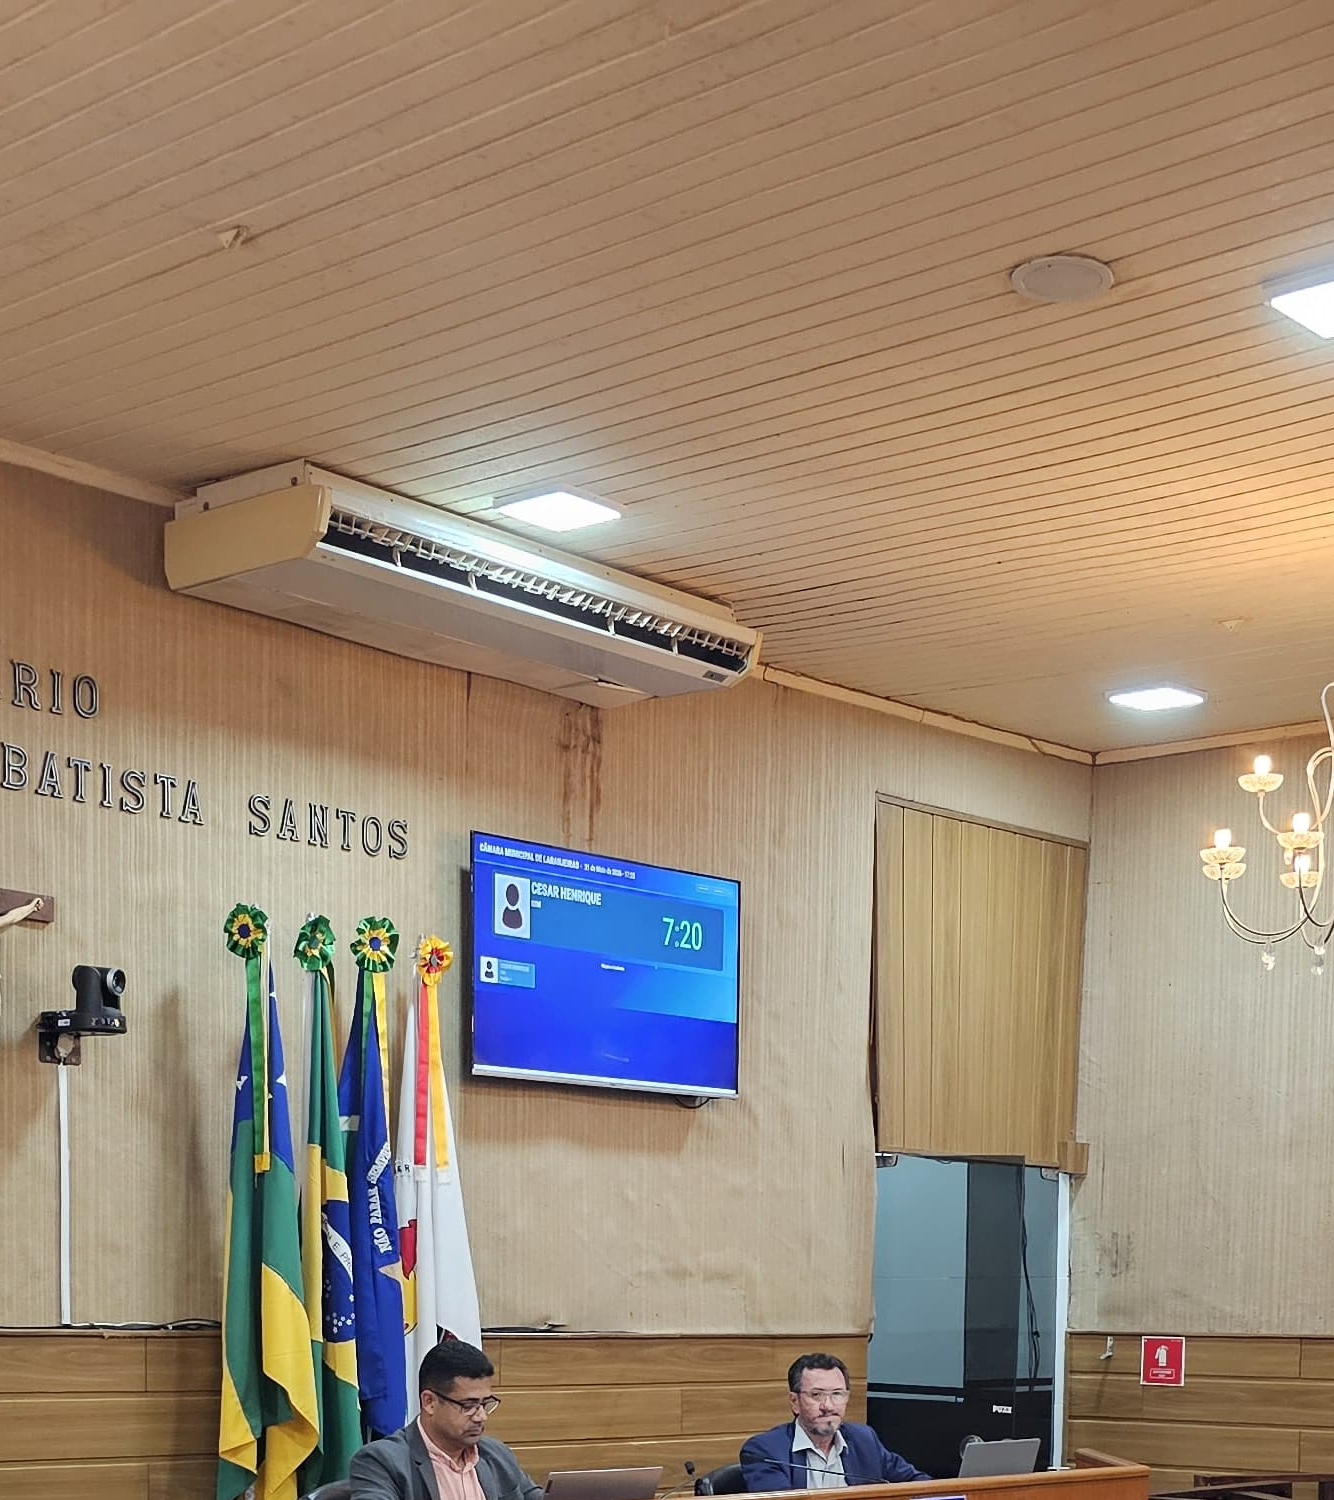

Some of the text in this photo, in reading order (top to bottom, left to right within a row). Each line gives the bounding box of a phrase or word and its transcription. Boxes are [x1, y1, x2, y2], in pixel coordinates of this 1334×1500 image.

[0, 741, 205, 825] BATISTA
[248, 792, 410, 860] SANTOS
[531, 881, 560, 899] CESAR
[560, 886, 602, 906] HENRIQUE
[662, 917, 702, 951] 7:20
[367, 1185, 383, 1225] PARAR
[373, 1227, 393, 1254] NÃO
